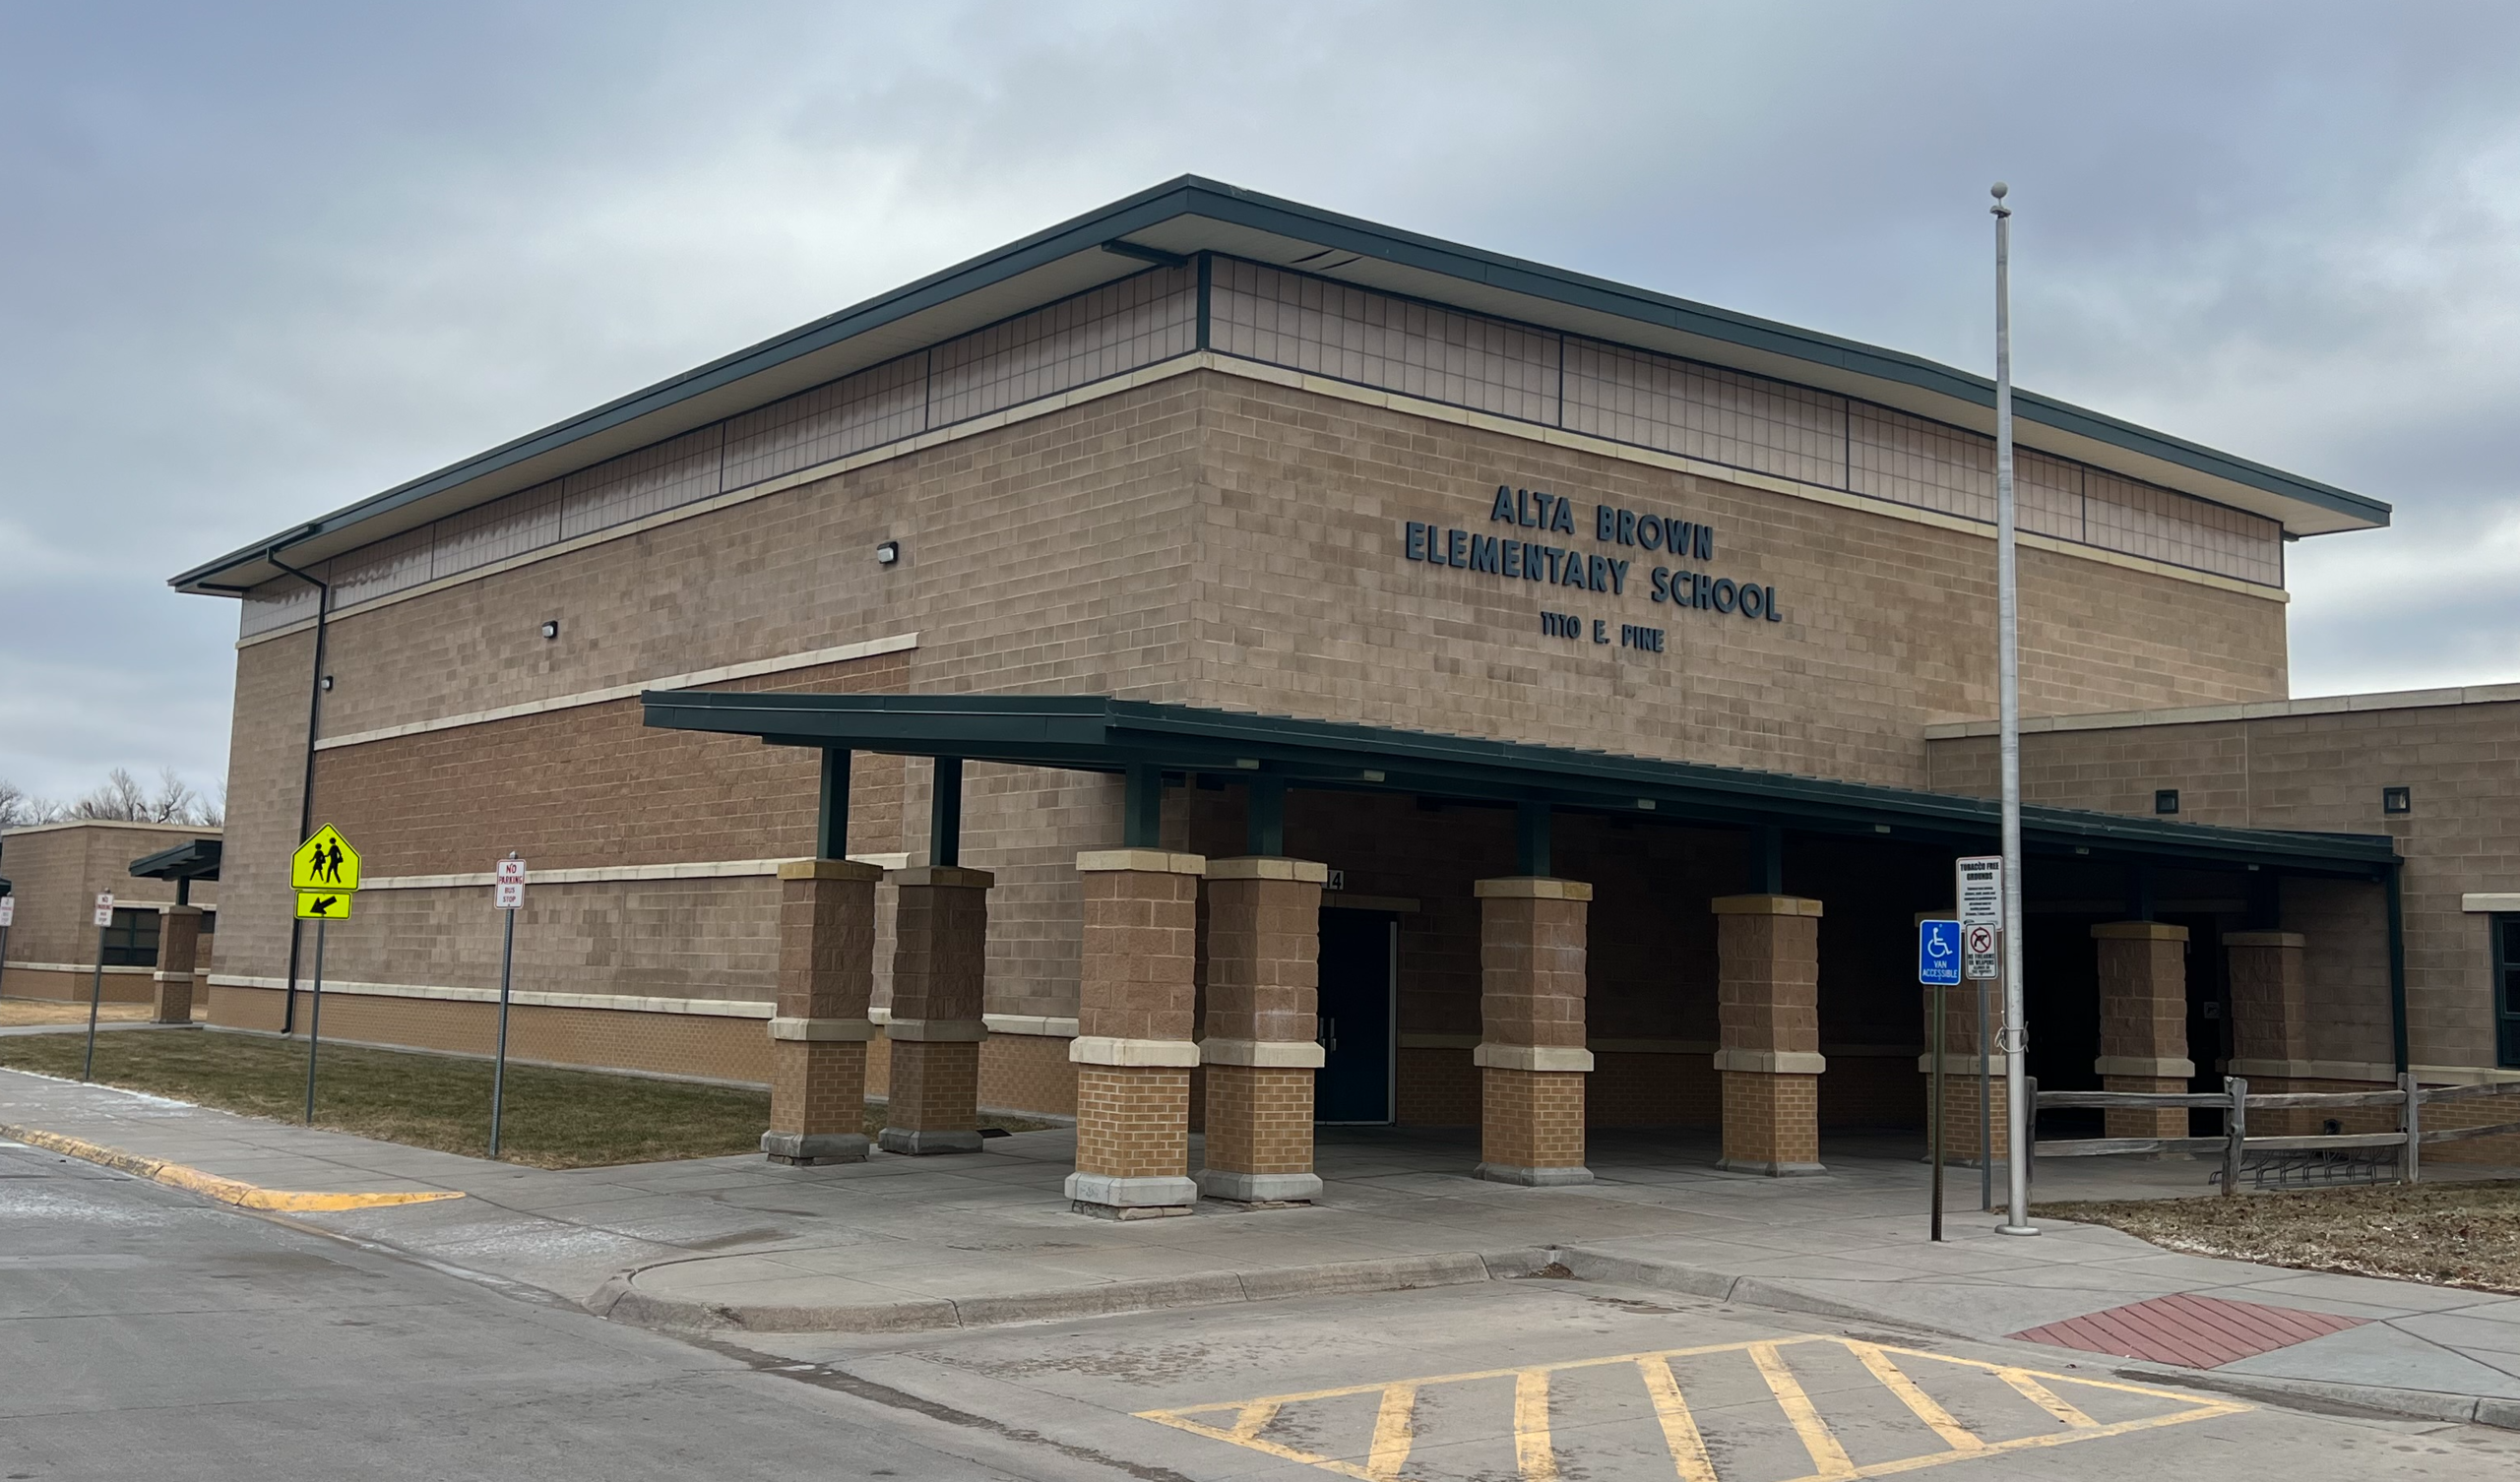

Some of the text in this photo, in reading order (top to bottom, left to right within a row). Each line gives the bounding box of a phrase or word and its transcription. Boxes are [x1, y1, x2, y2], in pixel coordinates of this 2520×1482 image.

[1490, 485, 1713, 560] ALTA BROWN
[1406, 522, 1782, 621] ELEMENTARY SCHOOL
[1541, 611, 1665, 652] 1110 E. PINE
[506, 865, 517, 874] NO
[1960, 862, 1985, 872] TOBACCO
[499, 876, 523, 885] PARKING
[1967, 872, 1992, 881] GROUNDS
[1922, 969, 1958, 978] ACCESSIBLE
